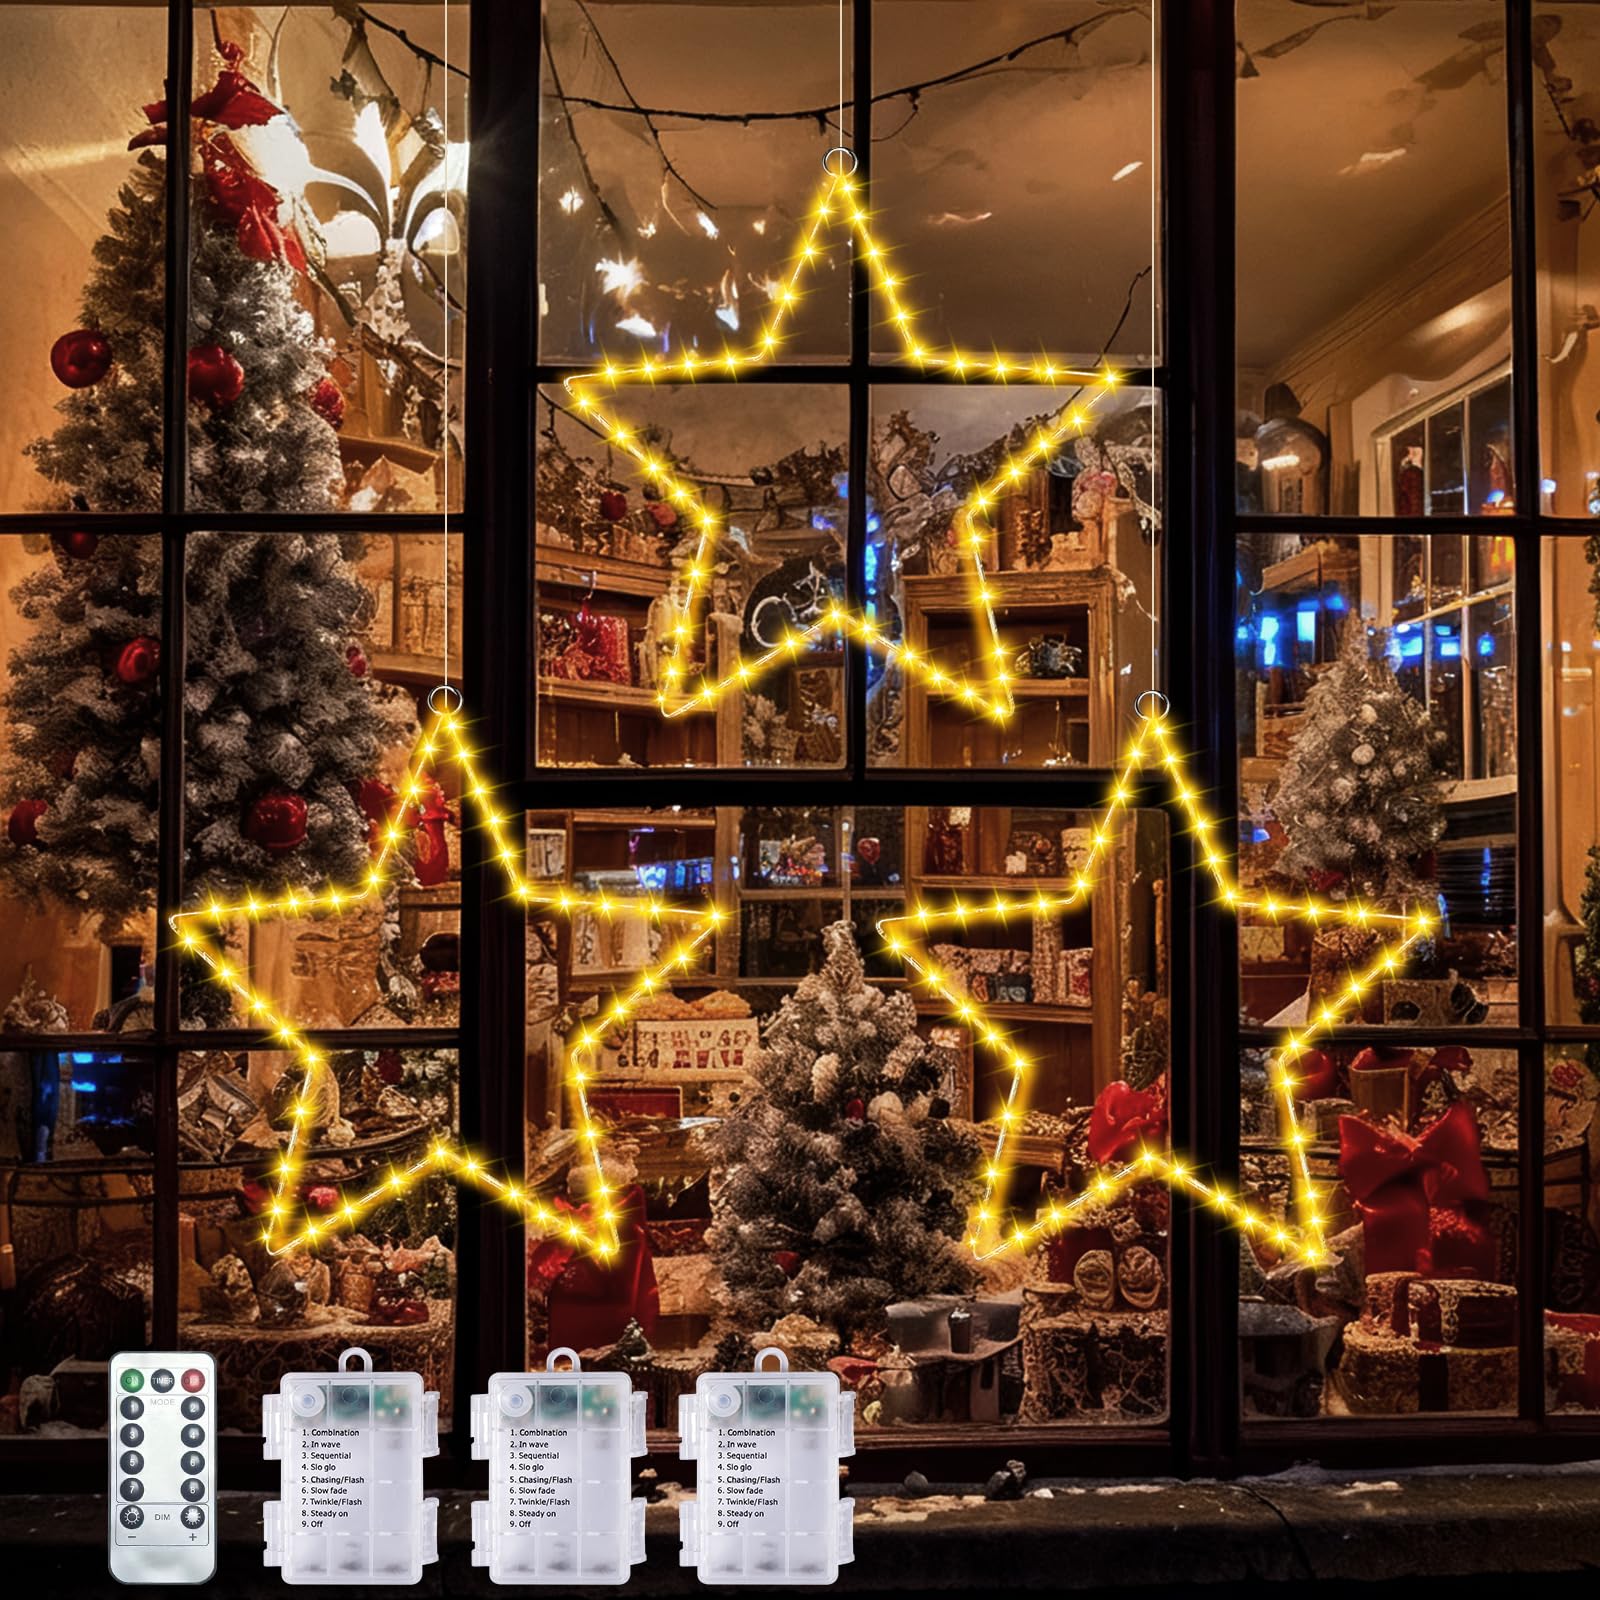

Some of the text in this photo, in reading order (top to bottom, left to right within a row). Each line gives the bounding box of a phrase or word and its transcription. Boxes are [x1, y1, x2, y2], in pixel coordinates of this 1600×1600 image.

[152, 1377, 174, 1385] TIMER
[150, 1398, 176, 1406] MODE
[302, 1428, 360, 1437] 1. Combination
[510, 1428, 568, 1437] 1. Combination
[718, 1428, 776, 1437] 1. Combination
[301, 1440, 341, 1449] 2. In wave
[509, 1440, 549, 1449] 2. In wave
[717, 1440, 757, 1449] 2. In wave
[301, 1452, 352, 1460] 3. Sequential
[509, 1452, 560, 1460] 3. Sequential
[717, 1452, 768, 1460] 3. Sequential
[310, 1463, 323, 1471] Slo
[324, 1463, 336, 1472] glo
[518, 1463, 531, 1471] Slo
[532, 1463, 544, 1472] glo
[726, 1463, 739, 1471] Slo
[740, 1463, 752, 1472] glo
[301, 1476, 365, 1485] 5. Chasing/Flash
[509, 1476, 573, 1485] 5. Chasing/Flash
[717, 1476, 781, 1485] 5. Chasing/Flash
[301, 1486, 348, 1495] 6. Slow fade
[509, 1486, 556, 1495] 6. Slow fade
[717, 1486, 764, 1495] 6. Slow fade
[301, 1498, 363, 1506] 7. Twinkle/Flash
[509, 1498, 571, 1506] 7. Twinkle/Flash
[717, 1498, 779, 1506] 7. Twinkle/Flash
[154, 1513, 171, 1521] DIM
[301, 1509, 309, 1518] 8.
[310, 1509, 337, 1518] Steady
[509, 1509, 517, 1518] 8.
[518, 1509, 545, 1518] Steady
[717, 1509, 725, 1518] 8.
[726, 1509, 753, 1518] Steady
[301, 1520, 323, 1528] 9. Off
[509, 1520, 531, 1528] 9. Off
[717, 1520, 739, 1528] 9. Off
